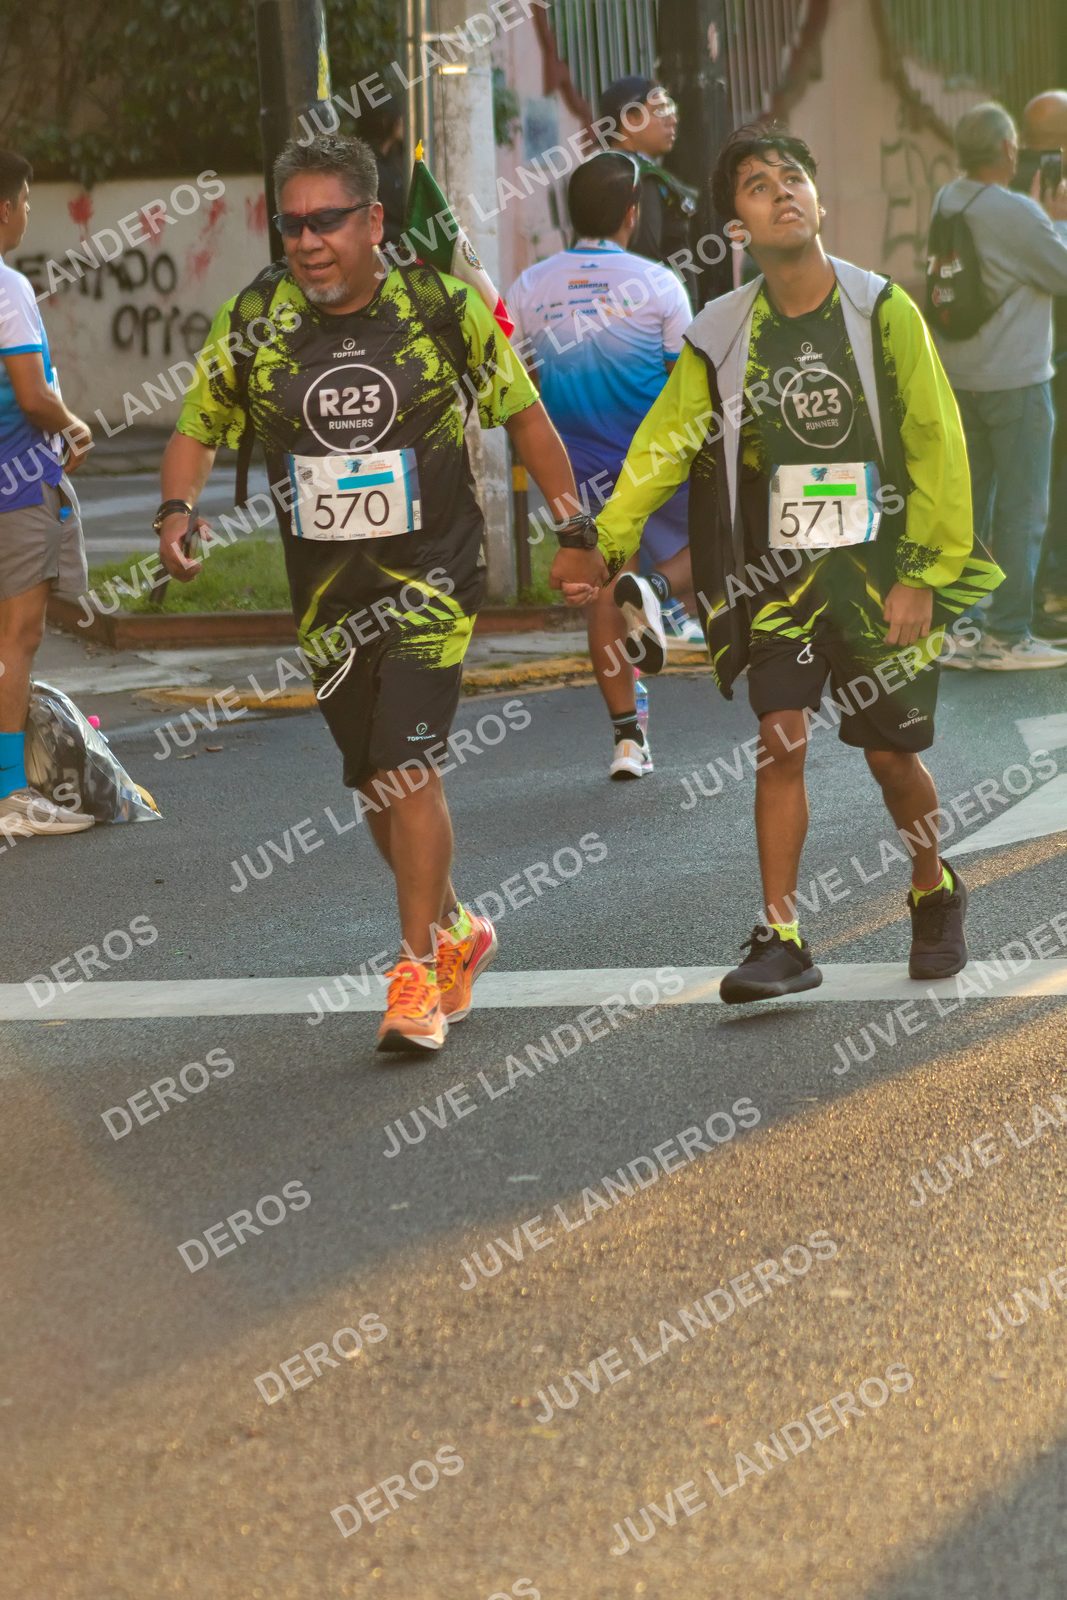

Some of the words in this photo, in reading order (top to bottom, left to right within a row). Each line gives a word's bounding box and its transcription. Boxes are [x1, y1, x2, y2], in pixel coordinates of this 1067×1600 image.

[332, 349, 366, 358] TOPTIME
[793, 353, 823, 362] TOPTIME
[318, 384, 381, 417] R23
[792, 388, 842, 419] R23
[328, 418, 374, 430] RUNNERS
[805, 419, 839, 430] RUNNERS
[313, 490, 390, 530] 570
[780, 500, 844, 538] 571
[898, 715, 928, 729] TOPTIME
